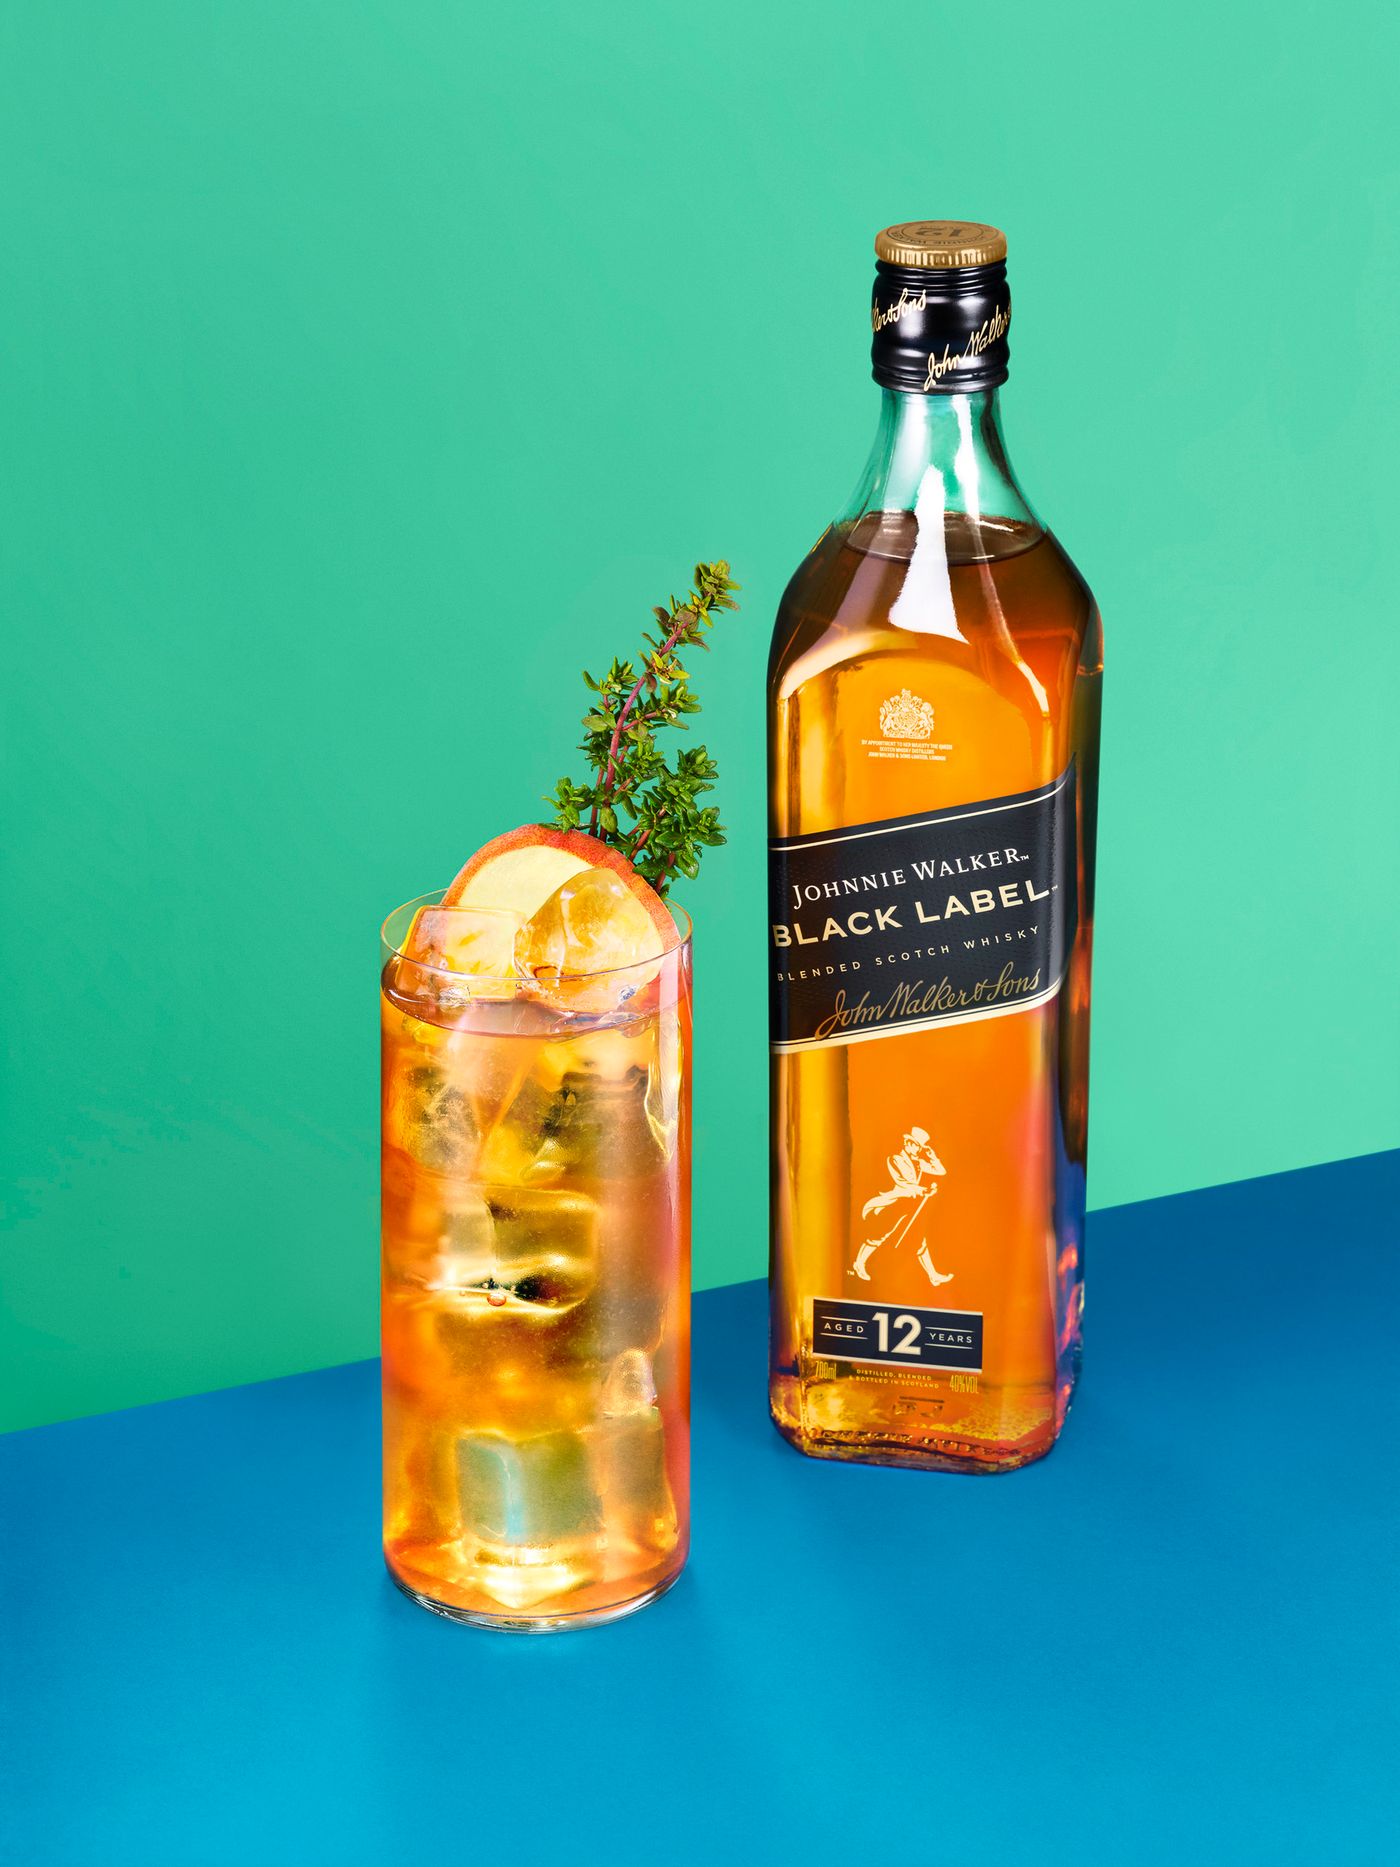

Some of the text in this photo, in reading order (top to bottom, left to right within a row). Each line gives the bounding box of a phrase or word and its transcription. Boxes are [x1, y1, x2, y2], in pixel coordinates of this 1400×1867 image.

[923, 343, 963, 392] John
[793, 869, 907, 910] JOHNNIE
[772, 905, 903, 948] BLACK
[777, 924, 1039, 982] BLENDED SCOTCH WHISKY
[814, 989, 884, 1041] John
[880, 975, 973, 1018] Walker
[987, 961, 1041, 1001] Sons
[823, 1311, 973, 1356] AGED 12 YEARS
[855, 1375, 889, 1384] BOTTLED
[901, 1380, 939, 1389] SCOTLAND
[897, 1372, 932, 1381] BLENDED
